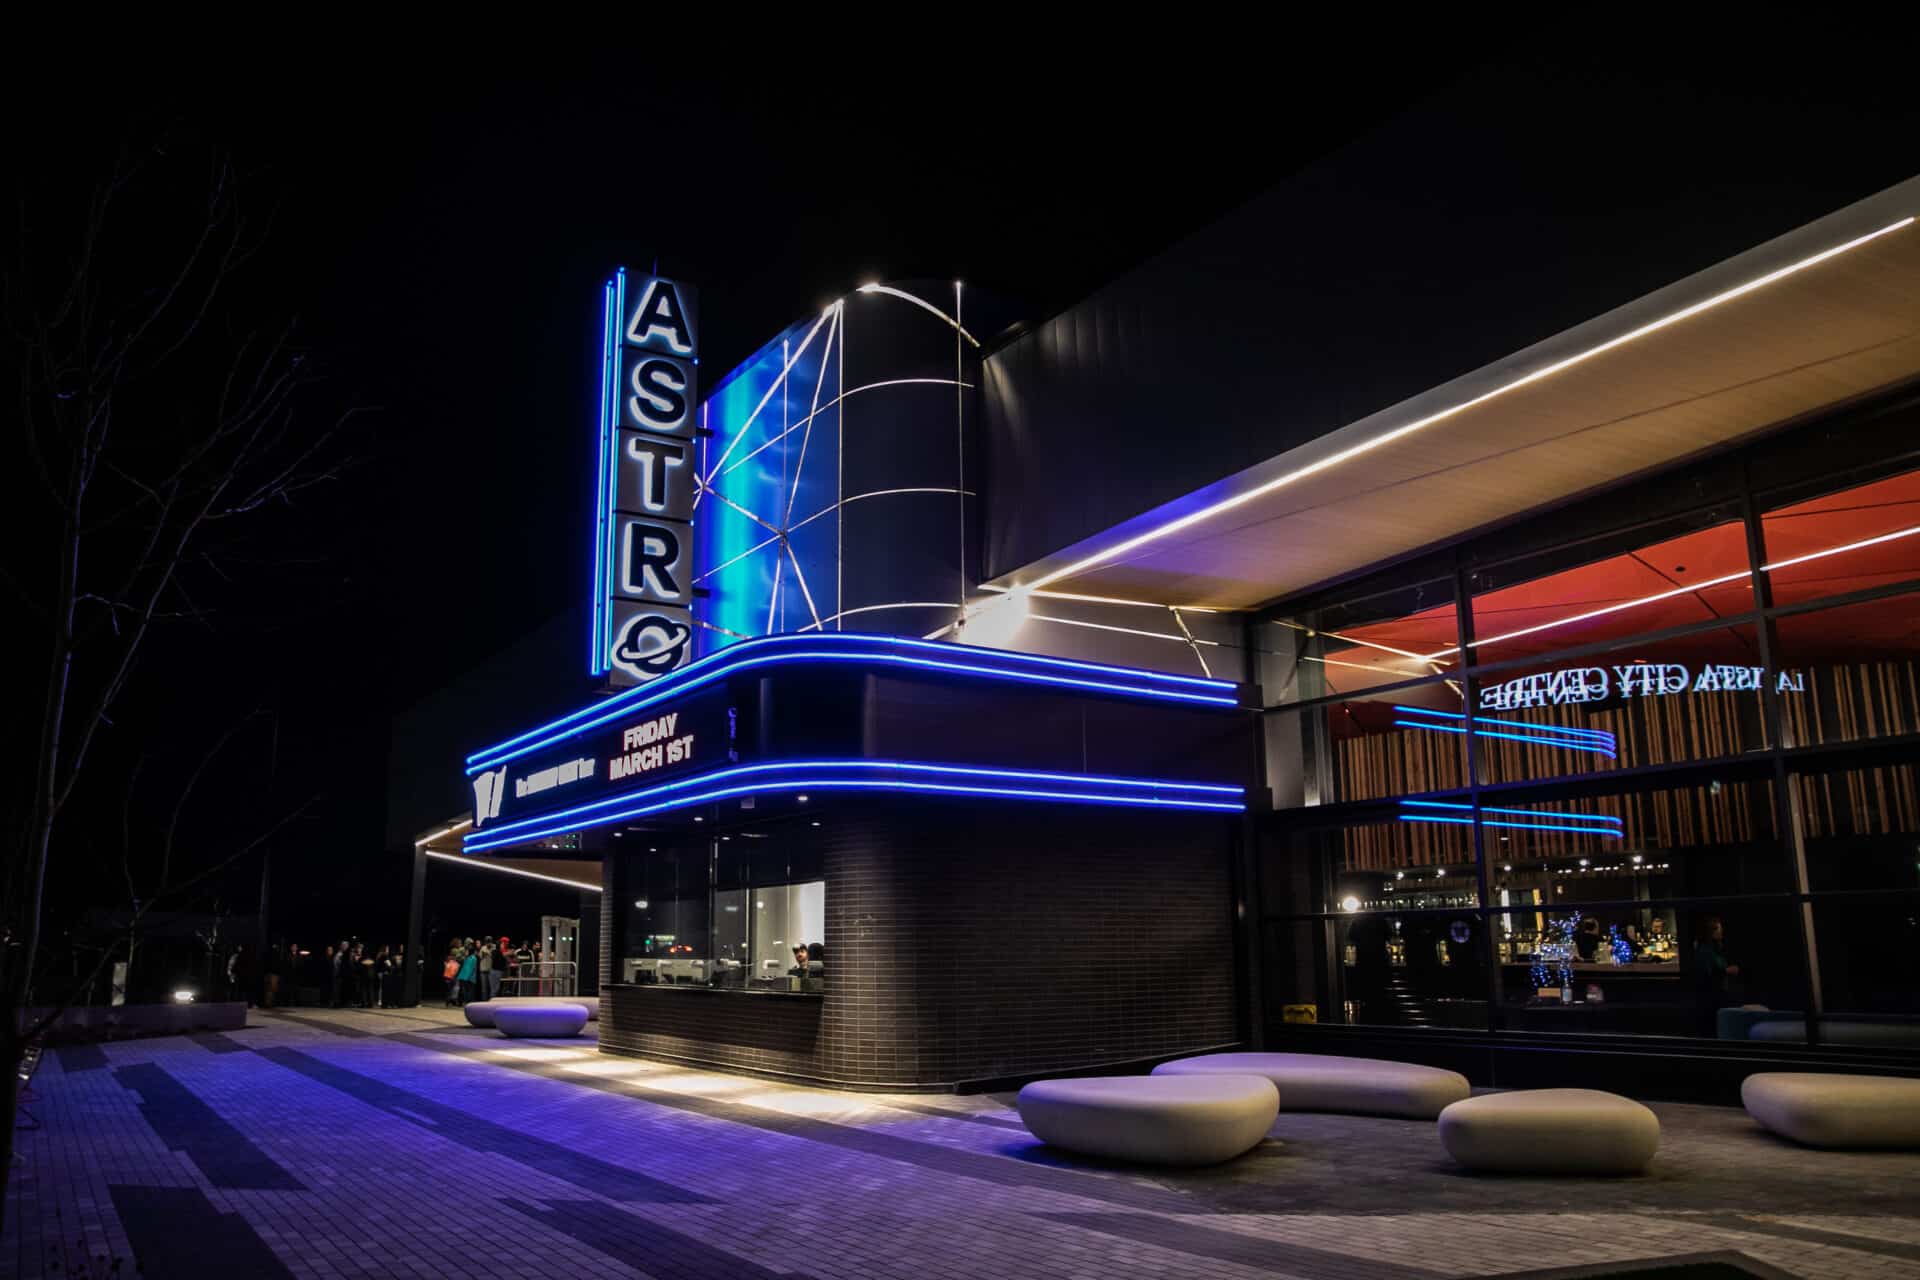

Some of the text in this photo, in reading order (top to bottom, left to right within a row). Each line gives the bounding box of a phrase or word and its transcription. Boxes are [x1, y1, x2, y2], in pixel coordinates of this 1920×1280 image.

[612, 278, 693, 682] ASTRO
[623, 712, 678, 751] FRIDAY
[609, 744, 663, 781] MARCH
[666, 734, 694, 764] 1ST
